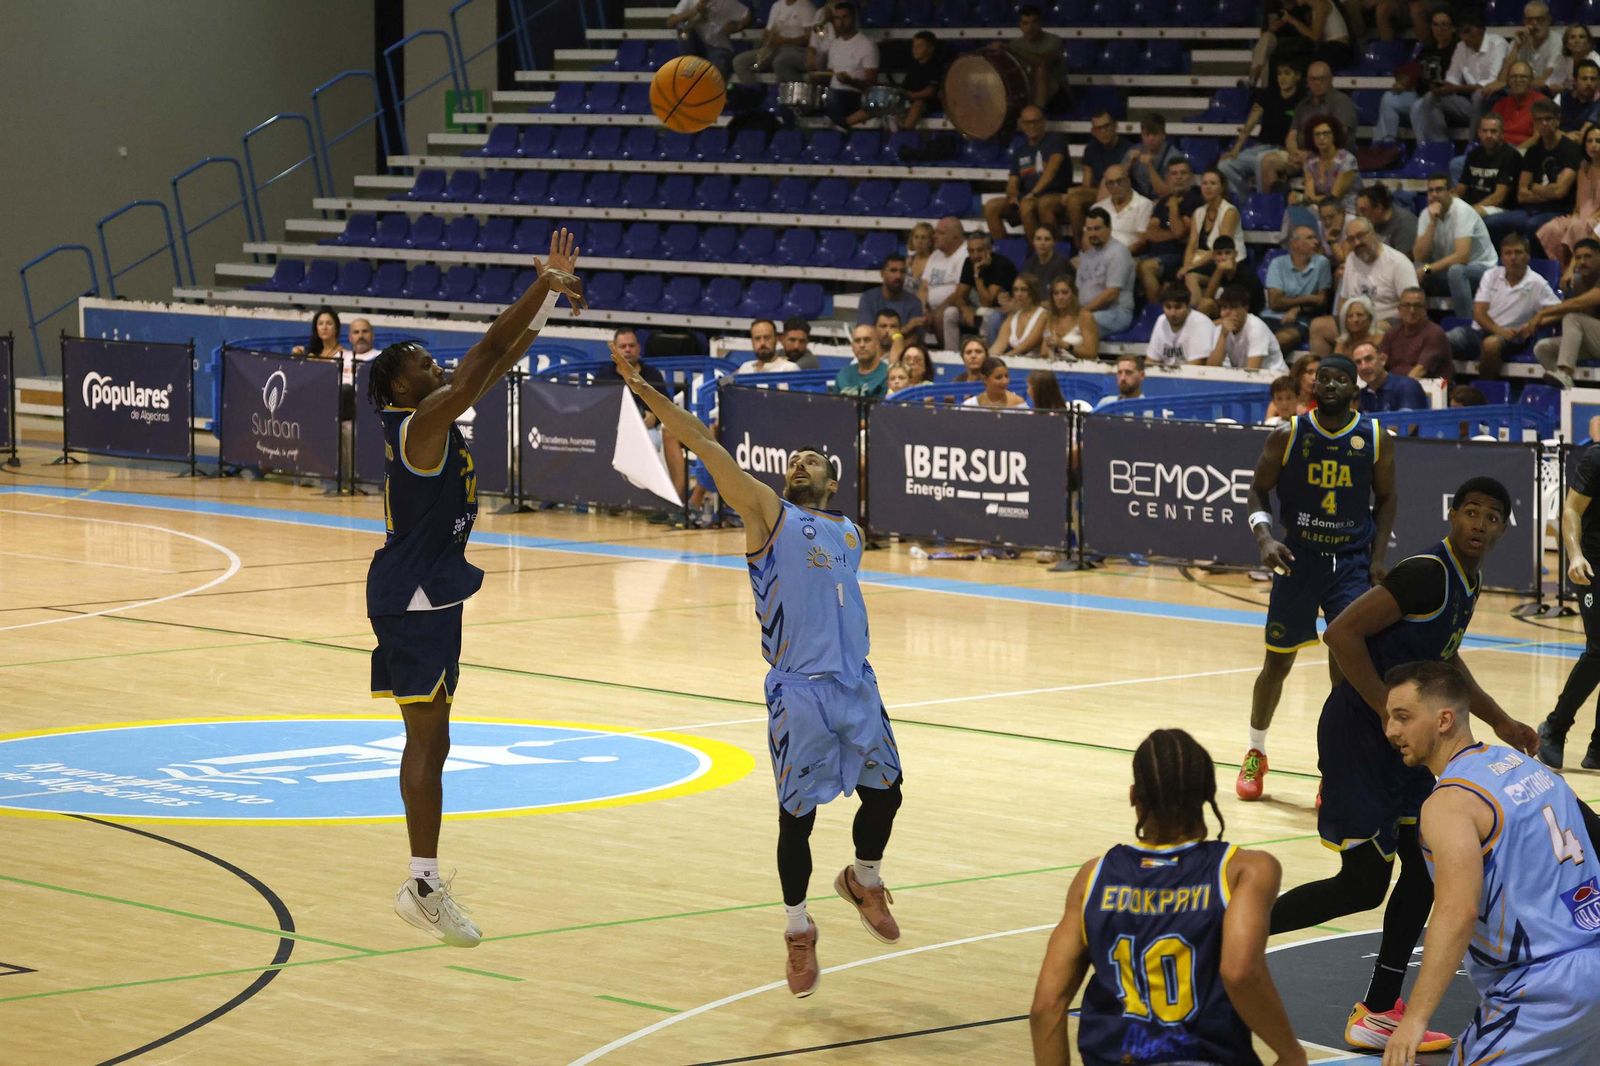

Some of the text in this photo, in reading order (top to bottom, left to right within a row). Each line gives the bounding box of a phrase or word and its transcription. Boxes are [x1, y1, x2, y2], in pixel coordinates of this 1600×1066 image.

[905, 444, 1030, 486] IBERSUR
[1307, 460, 1353, 488] CBA
[905, 478, 955, 501] Energía
[1321, 491, 1337, 515] 4
[1128, 500, 1234, 525] CENTER
[836, 583, 845, 608] 1
[1541, 804, 1585, 866] 4
[1101, 884, 1210, 915] EDOKPAYI
[1108, 933, 1198, 1027] 10
